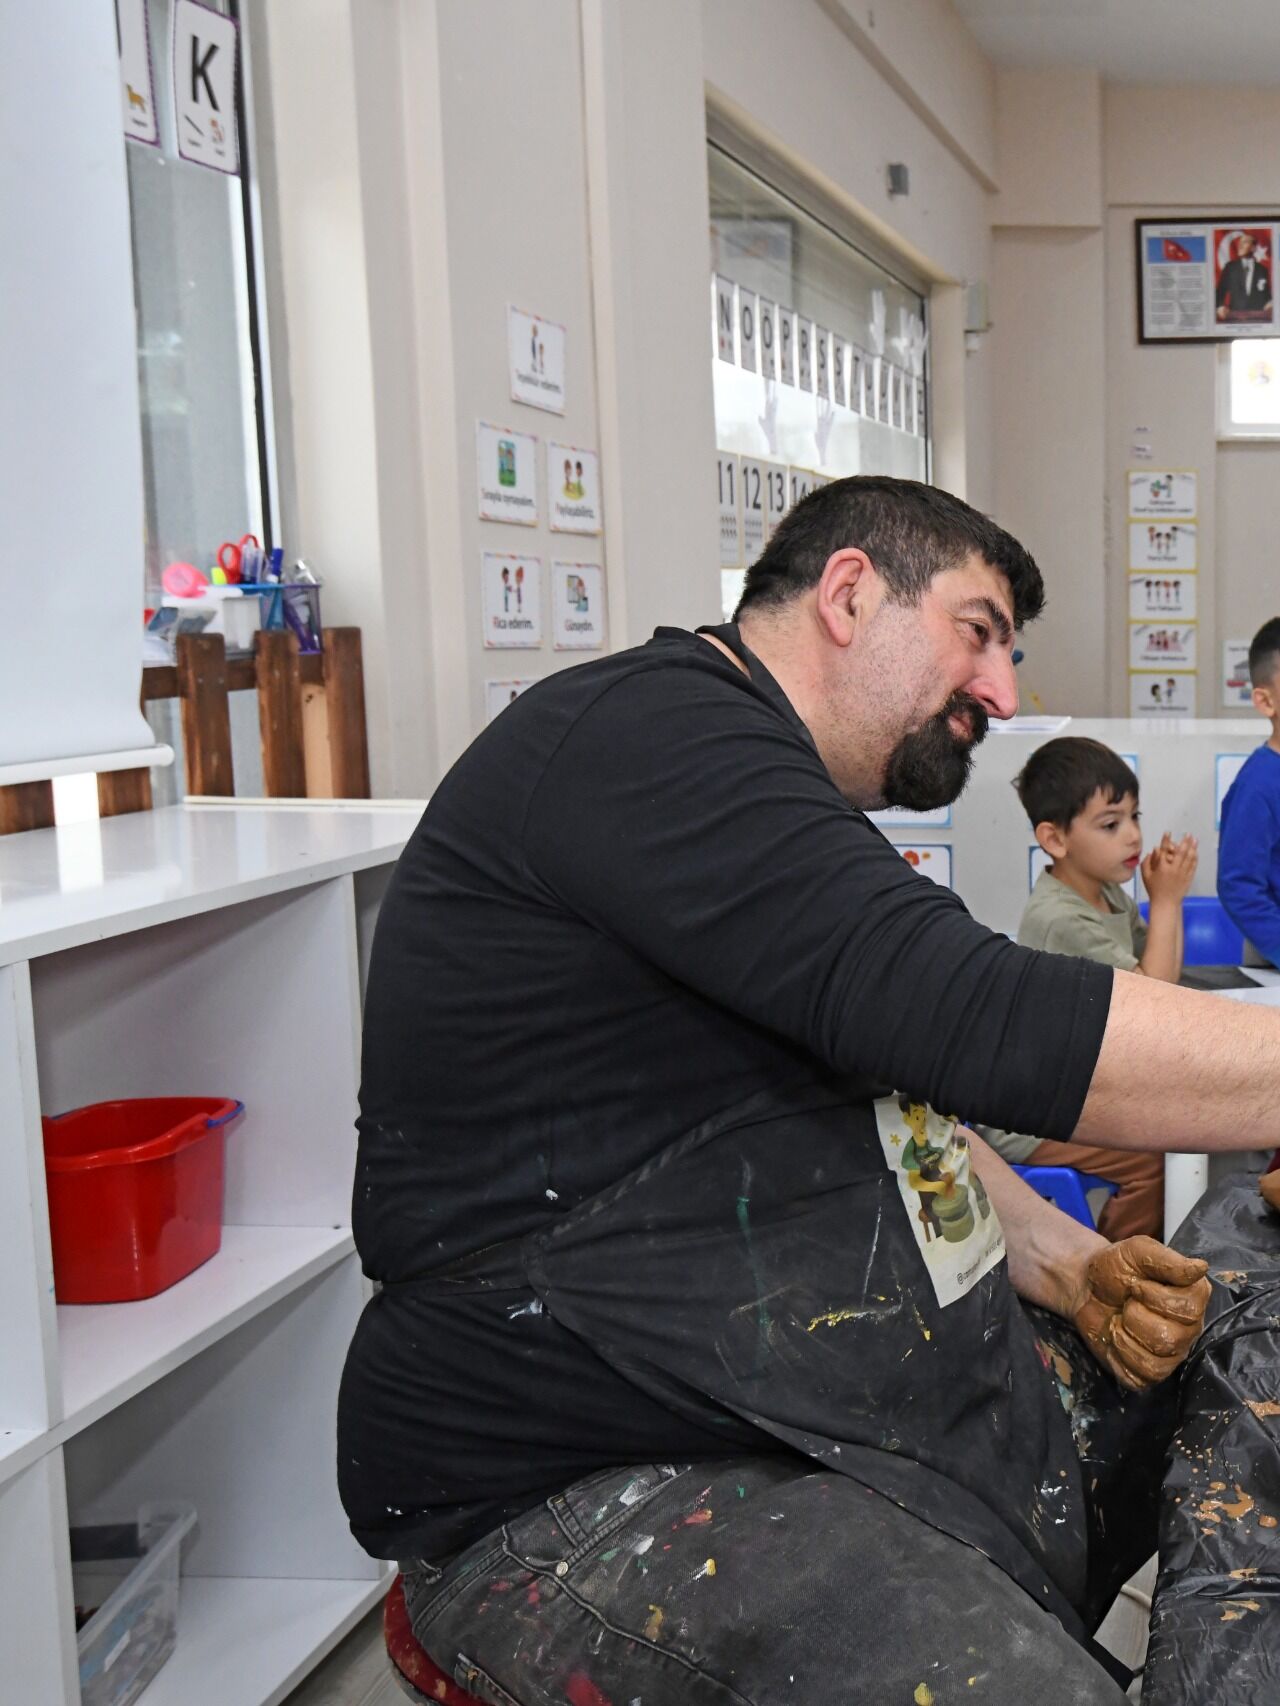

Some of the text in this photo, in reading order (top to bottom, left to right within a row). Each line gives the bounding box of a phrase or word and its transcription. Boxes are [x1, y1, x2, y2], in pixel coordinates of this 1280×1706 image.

[192, 34, 220, 112] K
[720, 293, 731, 331] N
[742, 305, 753, 340] O
[762, 307, 773, 348] Ö
[782, 318, 791, 351] P
[801, 328, 809, 361] R
[718, 460, 734, 506] 11
[743, 466, 761, 510] 12
[768, 471, 785, 513] 13
[492, 615, 534, 630] Rica ederim.
